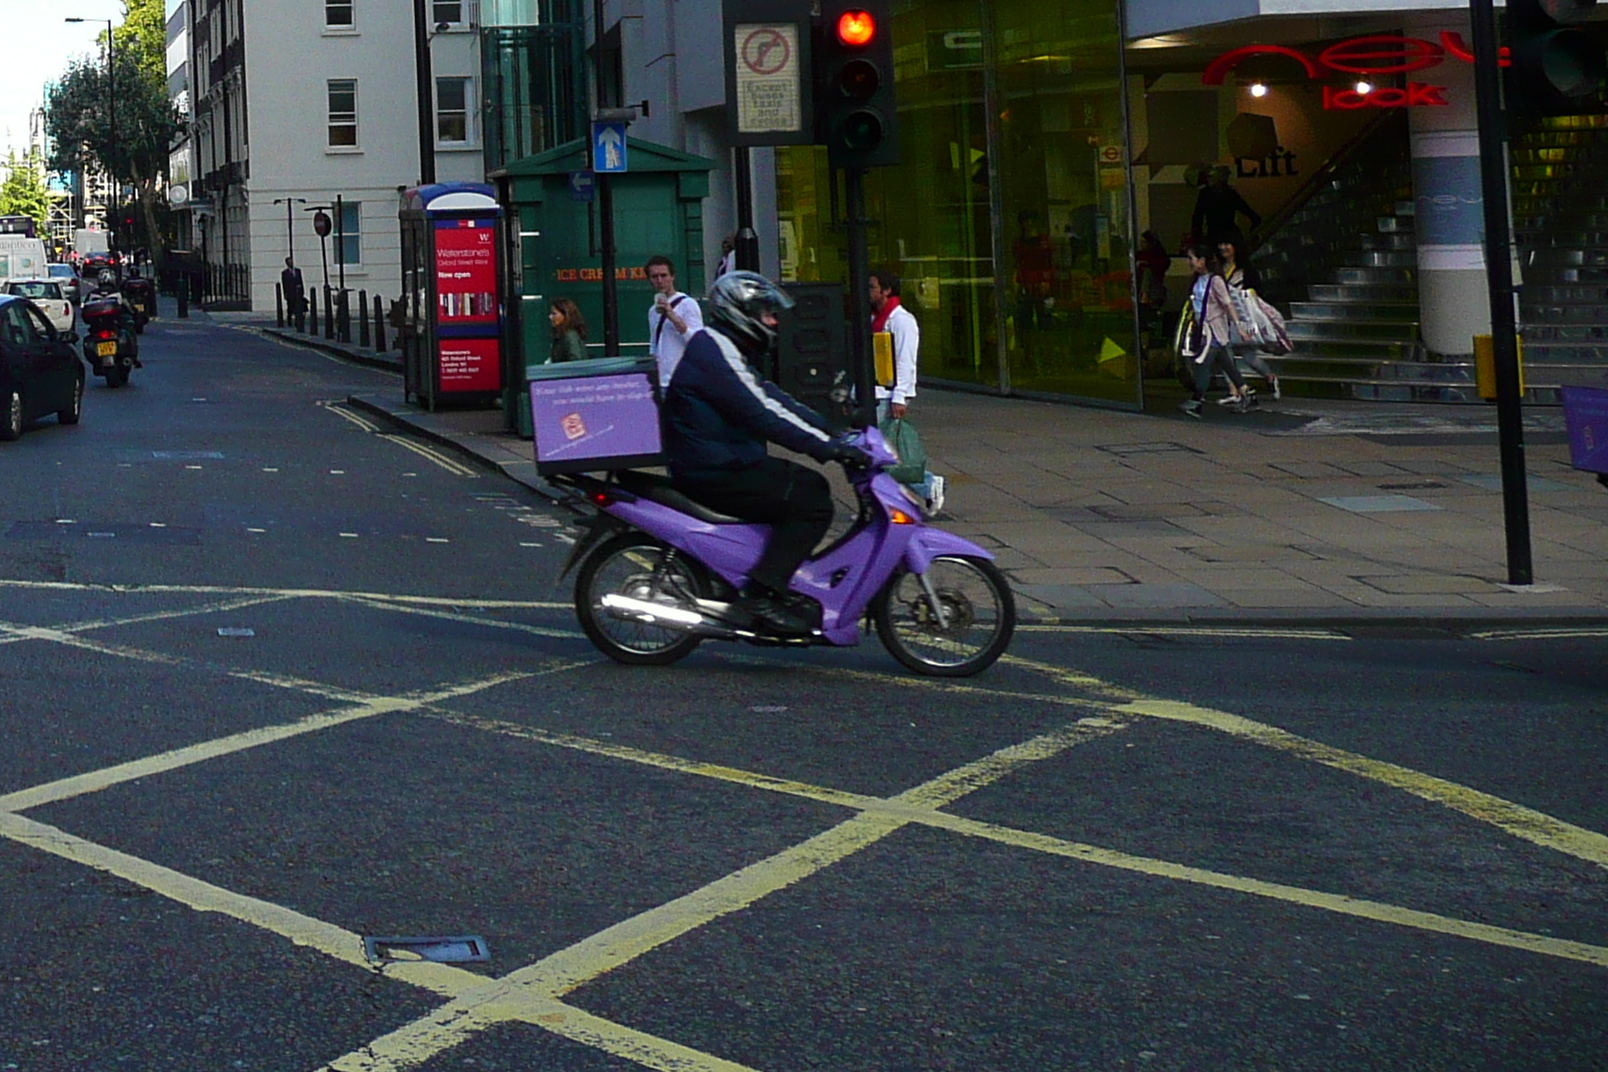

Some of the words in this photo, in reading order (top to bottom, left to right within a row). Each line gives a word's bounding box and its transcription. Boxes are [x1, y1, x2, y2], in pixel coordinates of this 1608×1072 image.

[1202, 31, 1510, 86] ne
[1323, 81, 1449, 110] look
[1236, 146, 1299, 178] Lift
[556, 269, 577, 281] ICE
[579, 267, 629, 281] CREM
